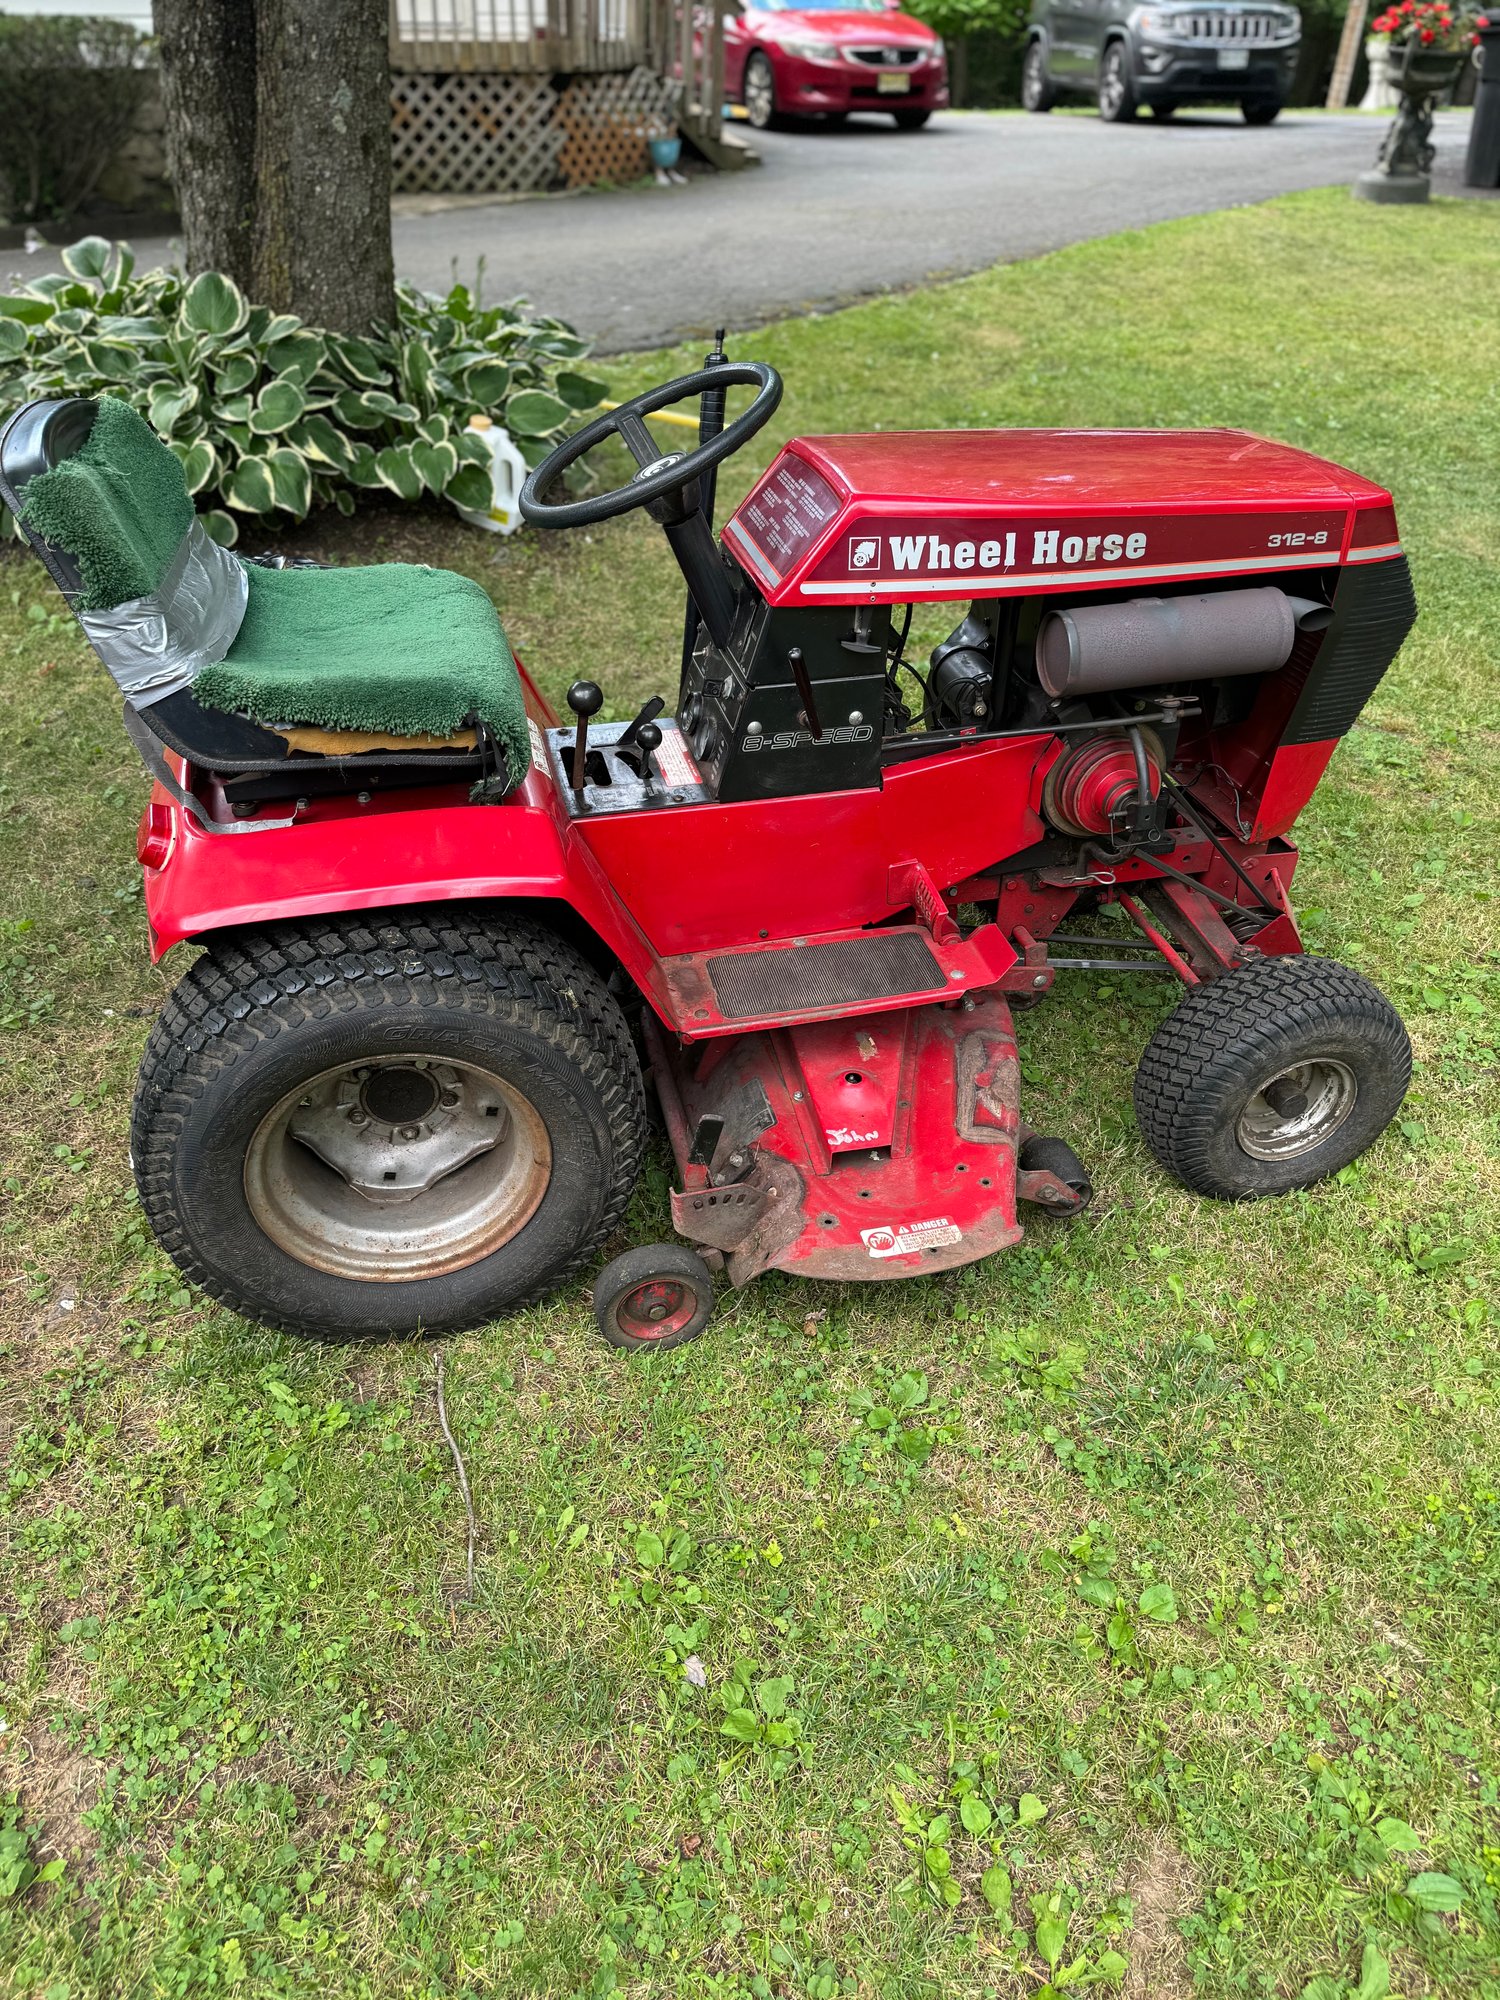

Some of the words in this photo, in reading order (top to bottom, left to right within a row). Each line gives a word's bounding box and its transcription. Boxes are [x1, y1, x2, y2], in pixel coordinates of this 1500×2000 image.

[1267, 531, 1328, 547] 312-8
[889, 532, 1017, 571] Wheel
[1031, 530, 1147, 565] Horse
[742, 725, 873, 752] 8-SPEED
[825, 1127, 879, 1146] John
[909, 1218, 949, 1232] DANGER
